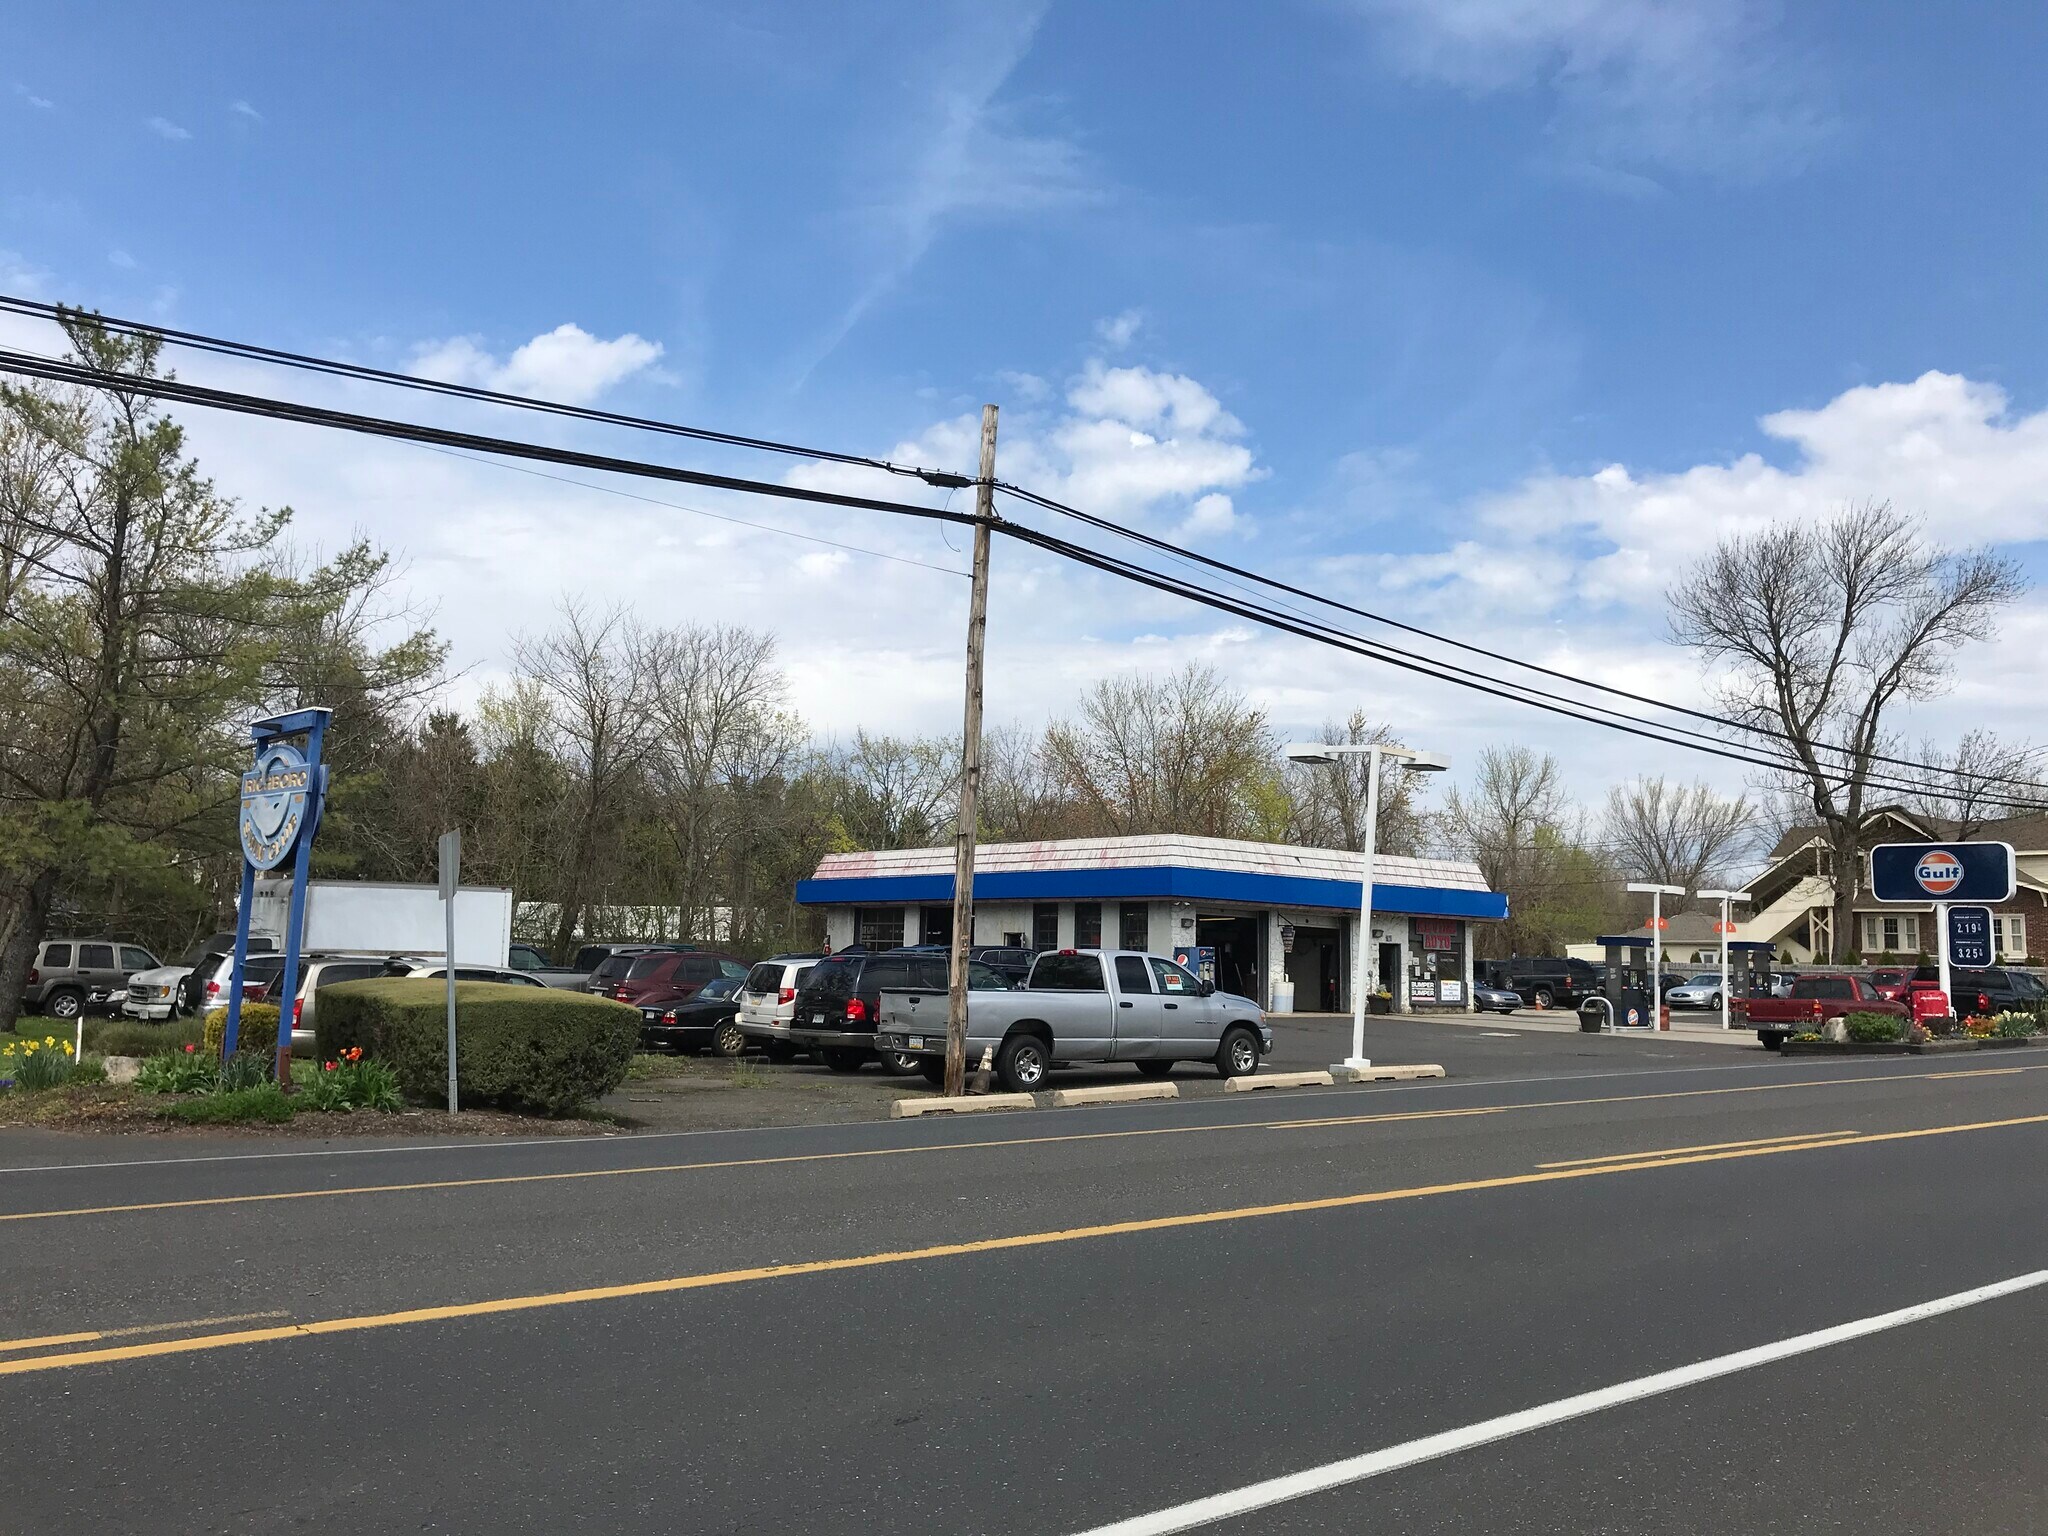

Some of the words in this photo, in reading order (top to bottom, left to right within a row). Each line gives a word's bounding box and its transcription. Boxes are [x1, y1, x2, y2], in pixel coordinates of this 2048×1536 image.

[245, 771, 307, 793] RICHBORO
[1919, 866, 1960, 878] Gulf
[1425, 935, 1450, 949] AUTO
